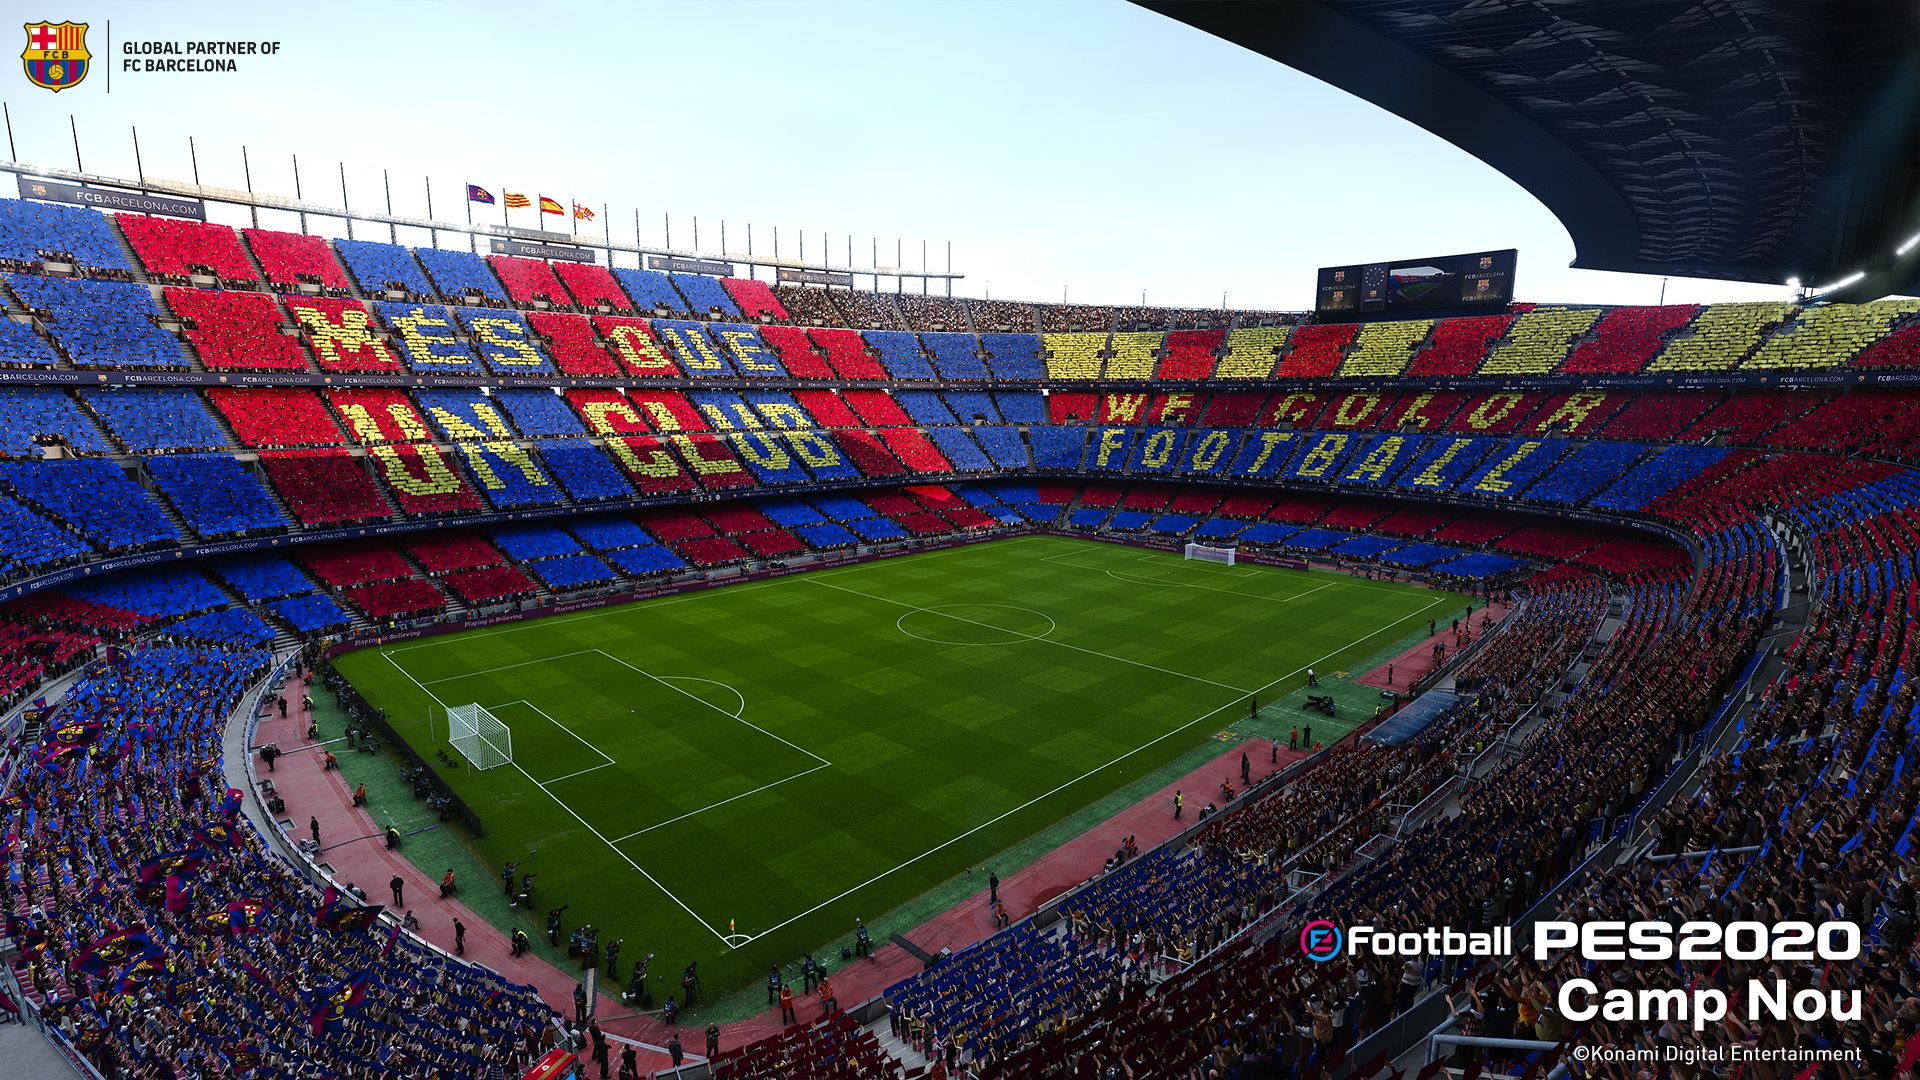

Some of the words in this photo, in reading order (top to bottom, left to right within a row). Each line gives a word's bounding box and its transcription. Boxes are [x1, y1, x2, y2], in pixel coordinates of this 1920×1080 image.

[76, 191, 198, 216] FCBARCELONA.COM
[520, 245, 592, 260] FCBARCELONA.COM
[609, 325, 776, 371] QUE
[339, 403, 549, 496] UN
[582, 402, 842, 478] CLUB
[1096, 428, 1542, 492] FOOTBALL
[196, 542, 258, 555] FCBARCELONA.COM
[464, 619, 488, 628] Playing
[495, 613, 523, 622] Believing
[389, 630, 421, 640] Believing
